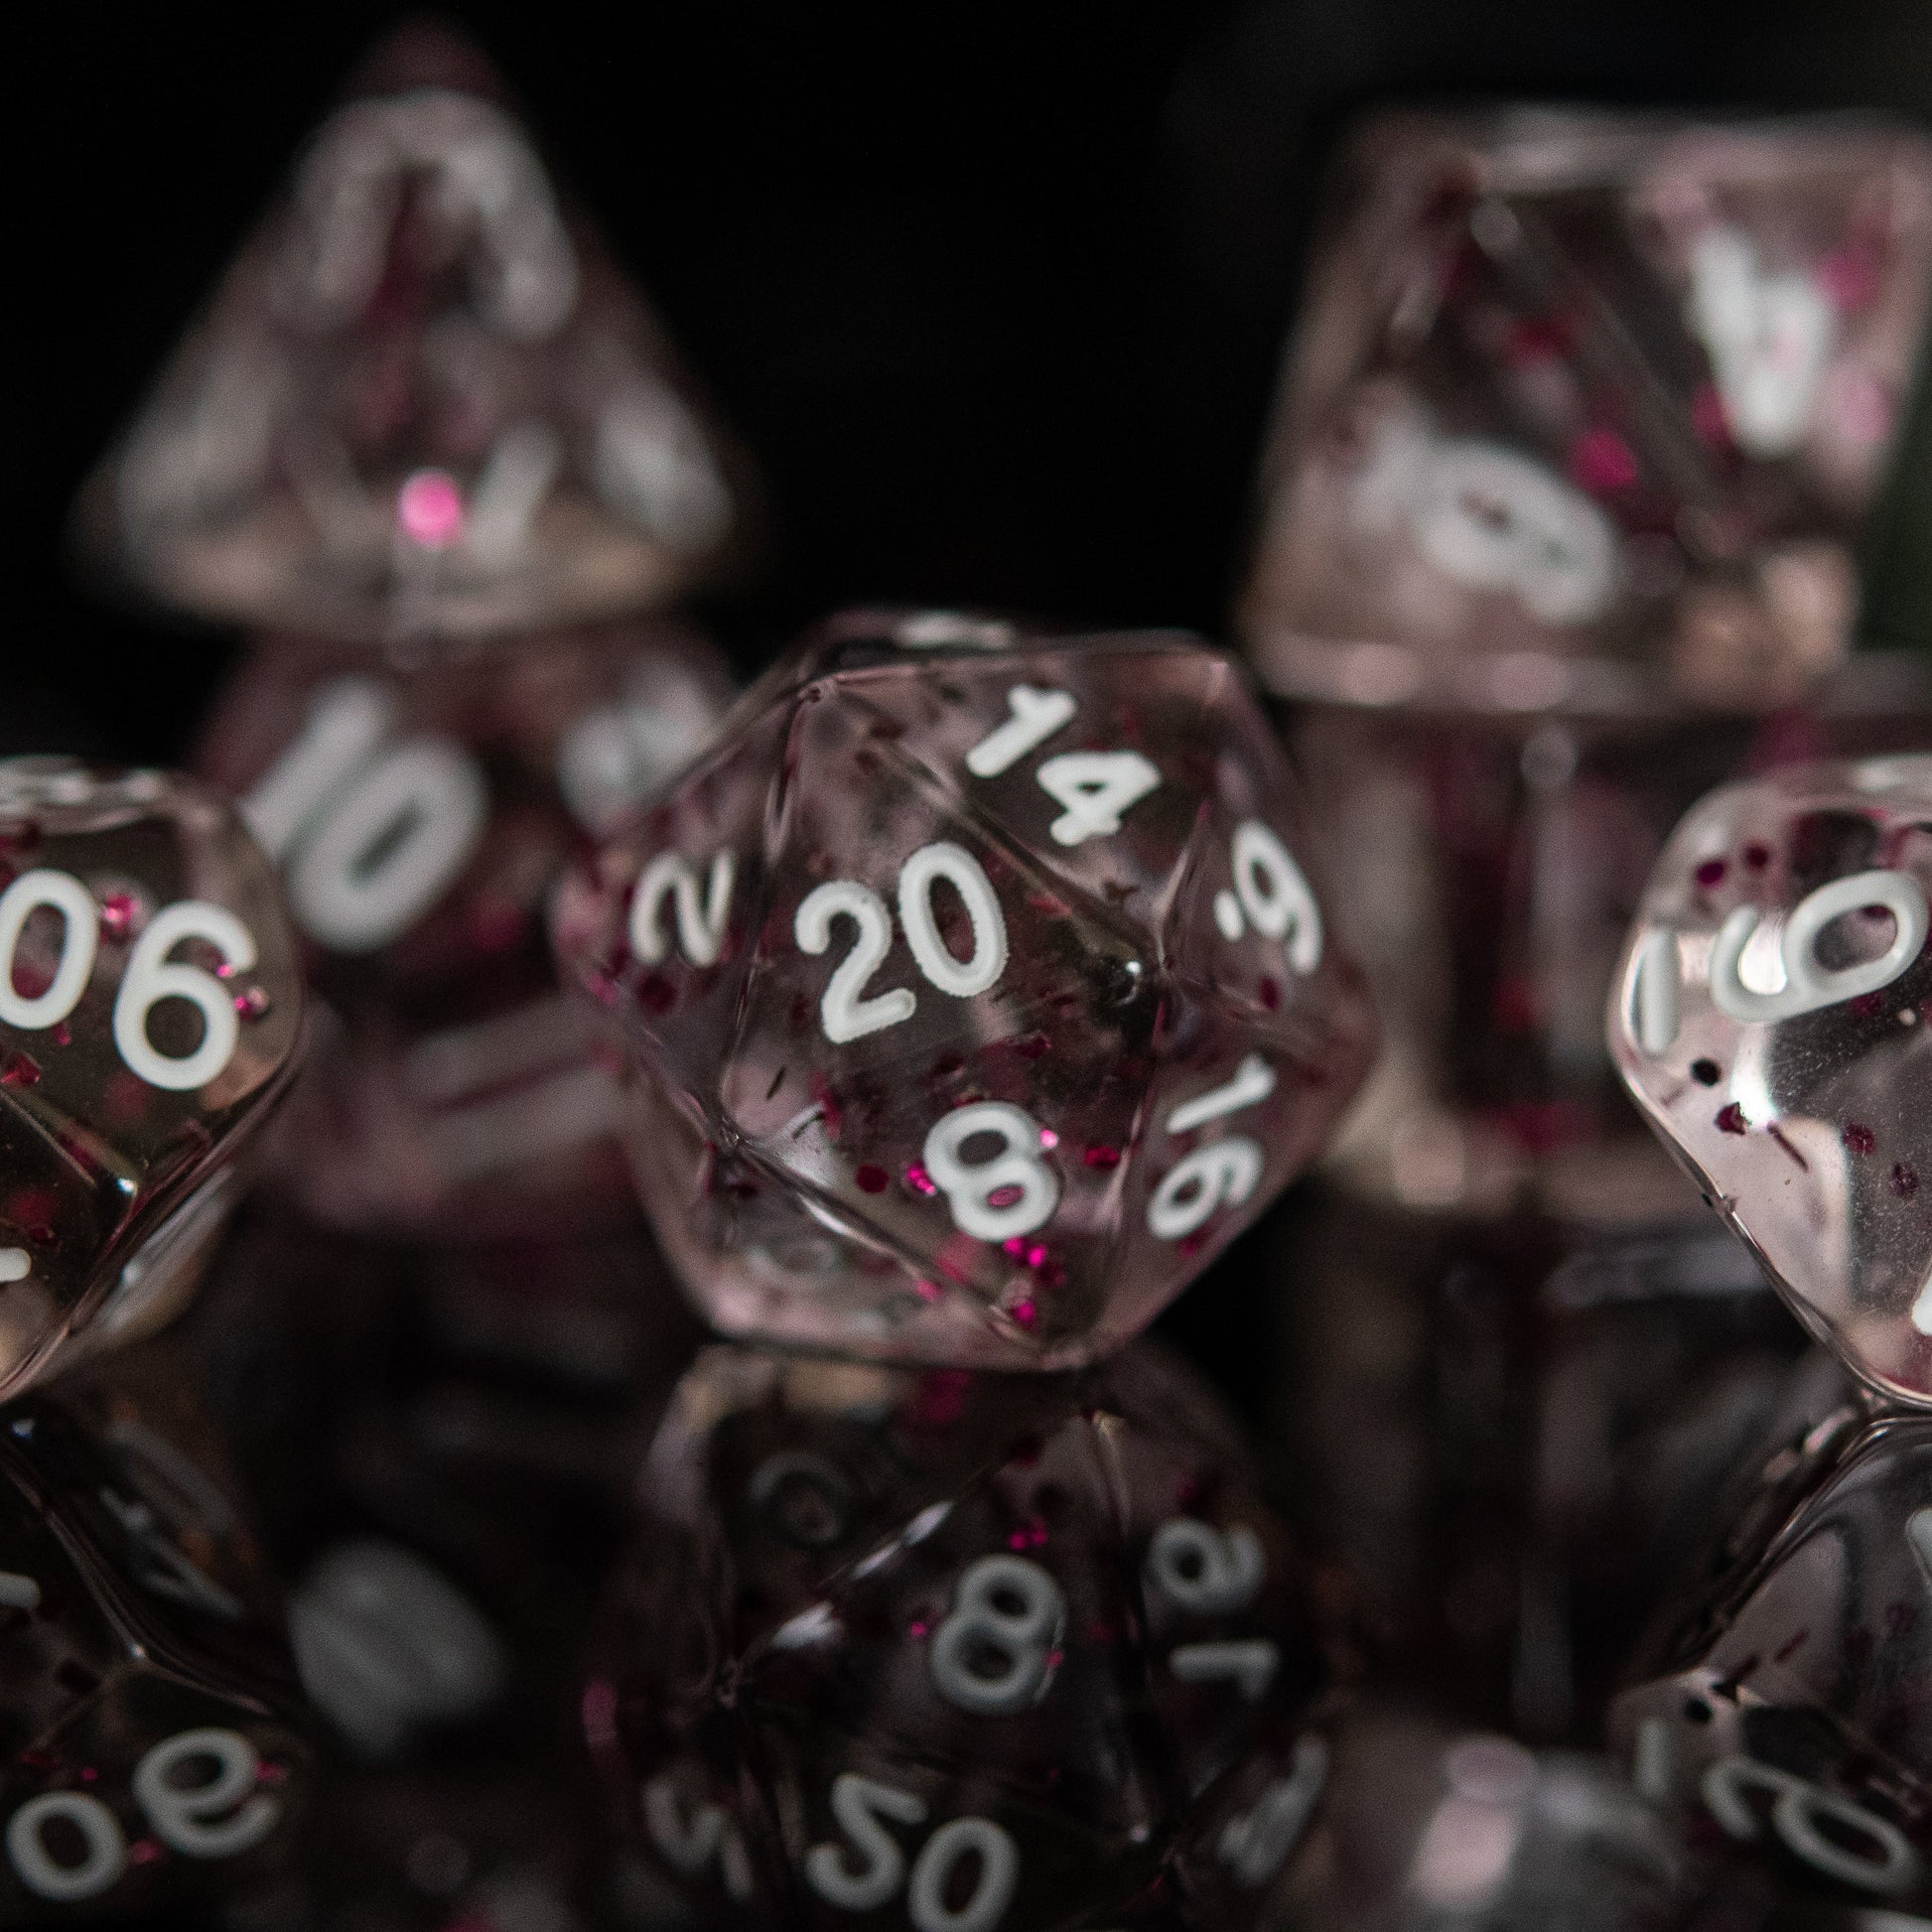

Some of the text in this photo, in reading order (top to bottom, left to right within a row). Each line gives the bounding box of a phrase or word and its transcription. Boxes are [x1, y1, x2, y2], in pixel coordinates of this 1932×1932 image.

[966, 685, 1160, 846] 14
[795, 841, 1009, 1044] 20
[923, 1102, 1059, 1242] 8
